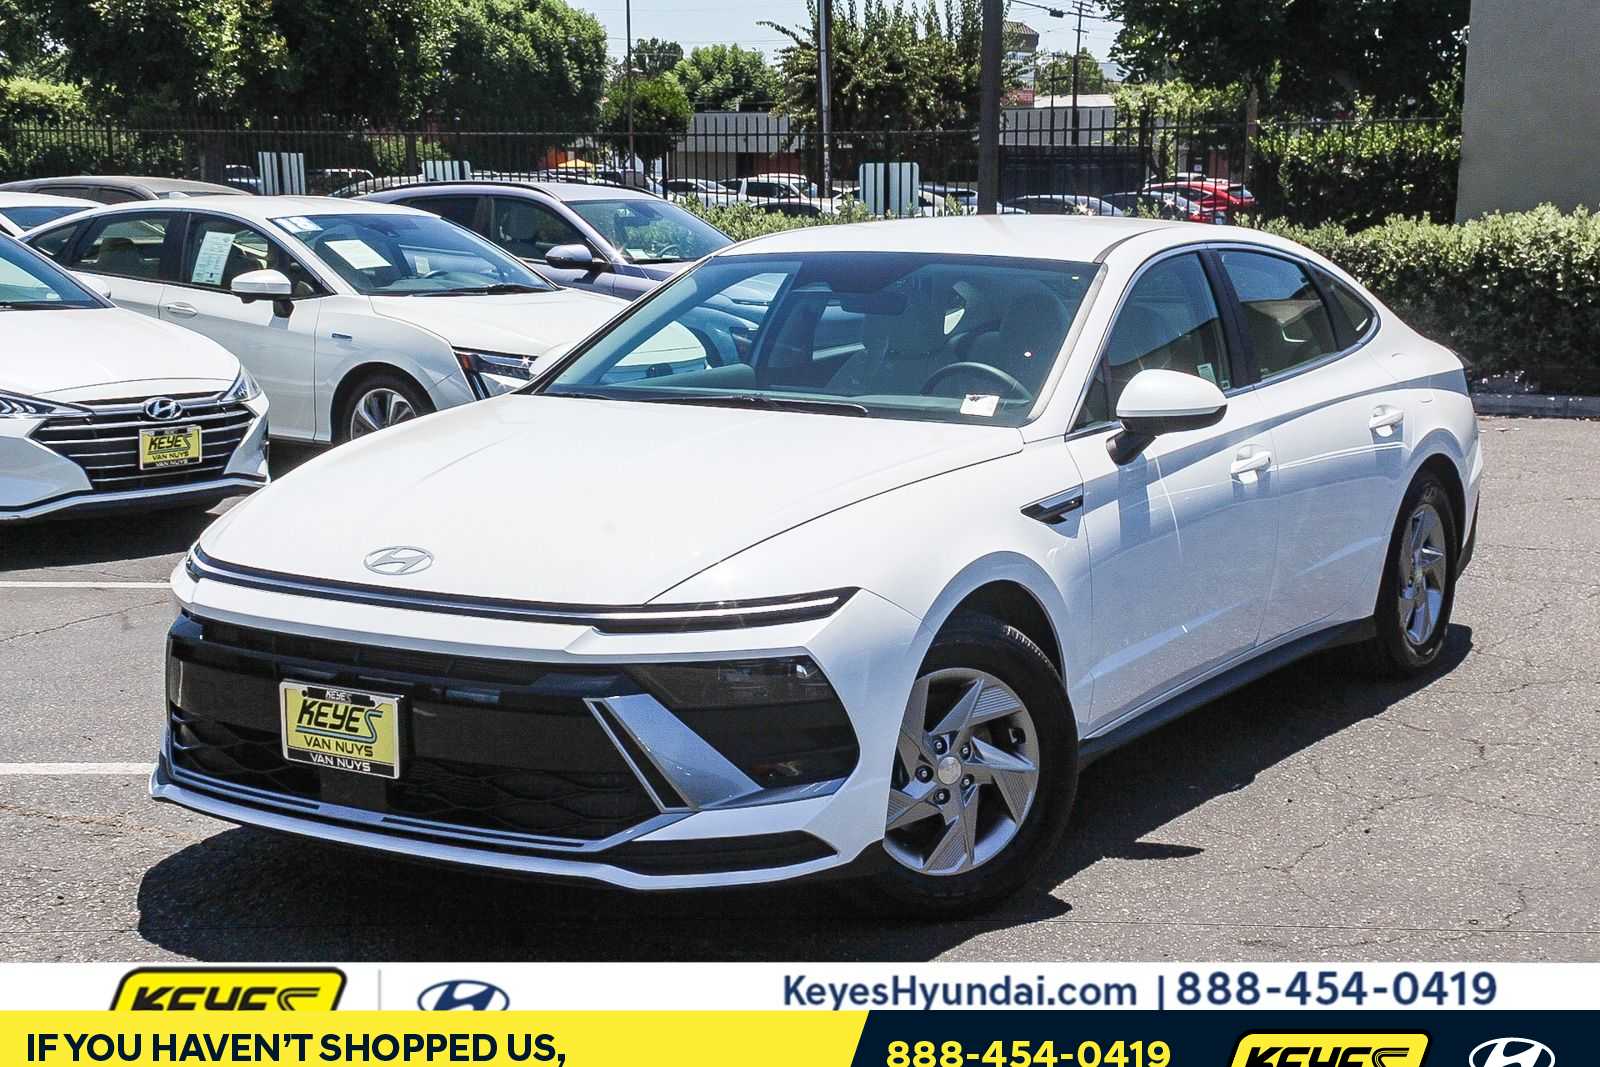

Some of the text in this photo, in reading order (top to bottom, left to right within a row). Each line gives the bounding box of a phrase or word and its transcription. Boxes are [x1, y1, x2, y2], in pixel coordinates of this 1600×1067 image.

[148, 433, 193, 453] KEYES
[325, 690, 352, 704] KEYES
[296, 698, 384, 743] KEYES
[304, 735, 374, 758] VAN NUYS
[310, 753, 371, 772] VAN NUYS
